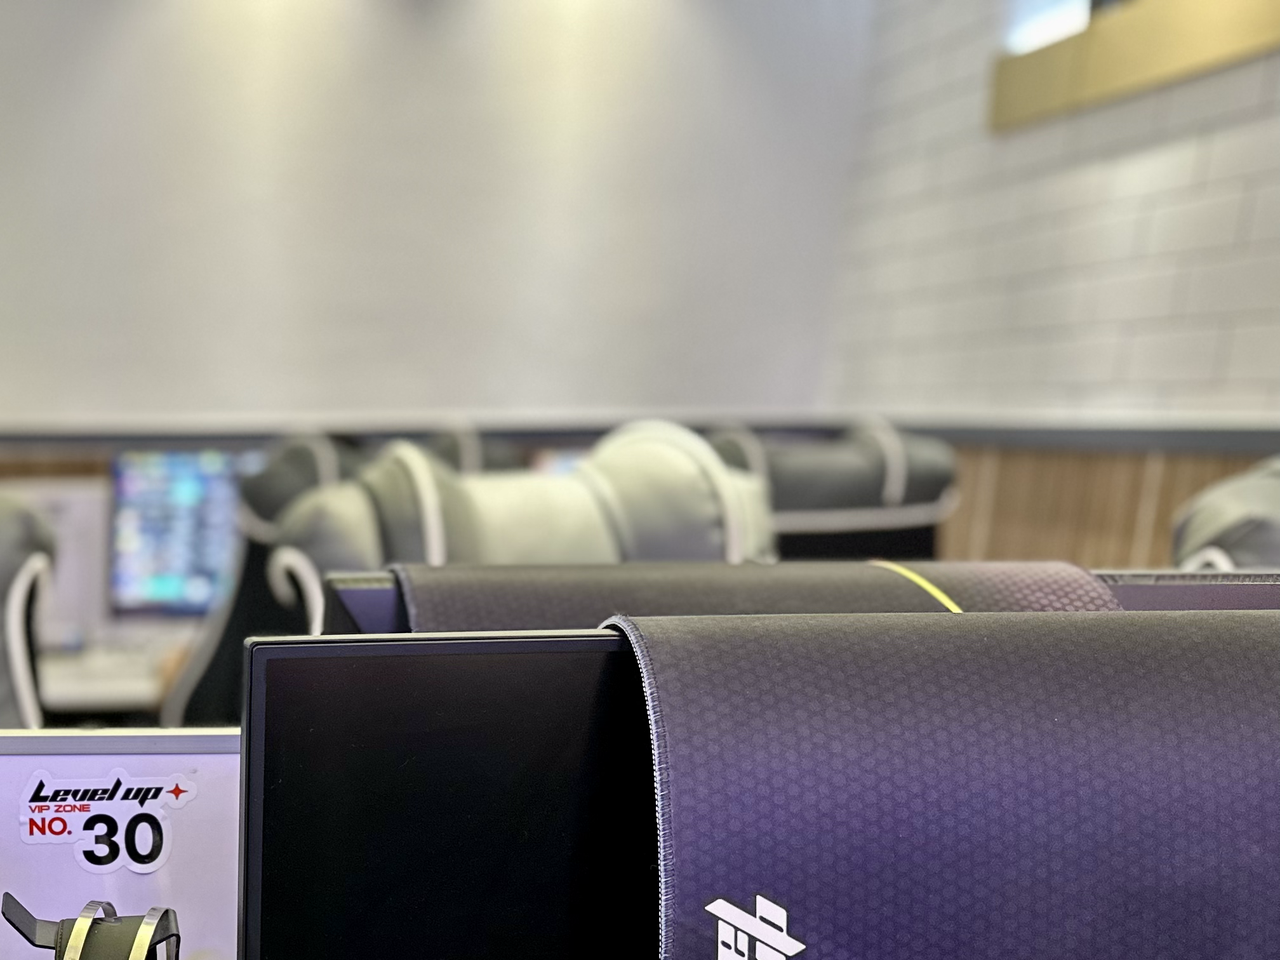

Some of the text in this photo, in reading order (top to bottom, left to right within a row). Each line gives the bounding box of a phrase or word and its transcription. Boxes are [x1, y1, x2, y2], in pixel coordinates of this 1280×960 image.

[28, 777, 164, 808] Level up
[28, 804, 91, 813] VIP ZONE
[28, 813, 163, 866] NO. 30
